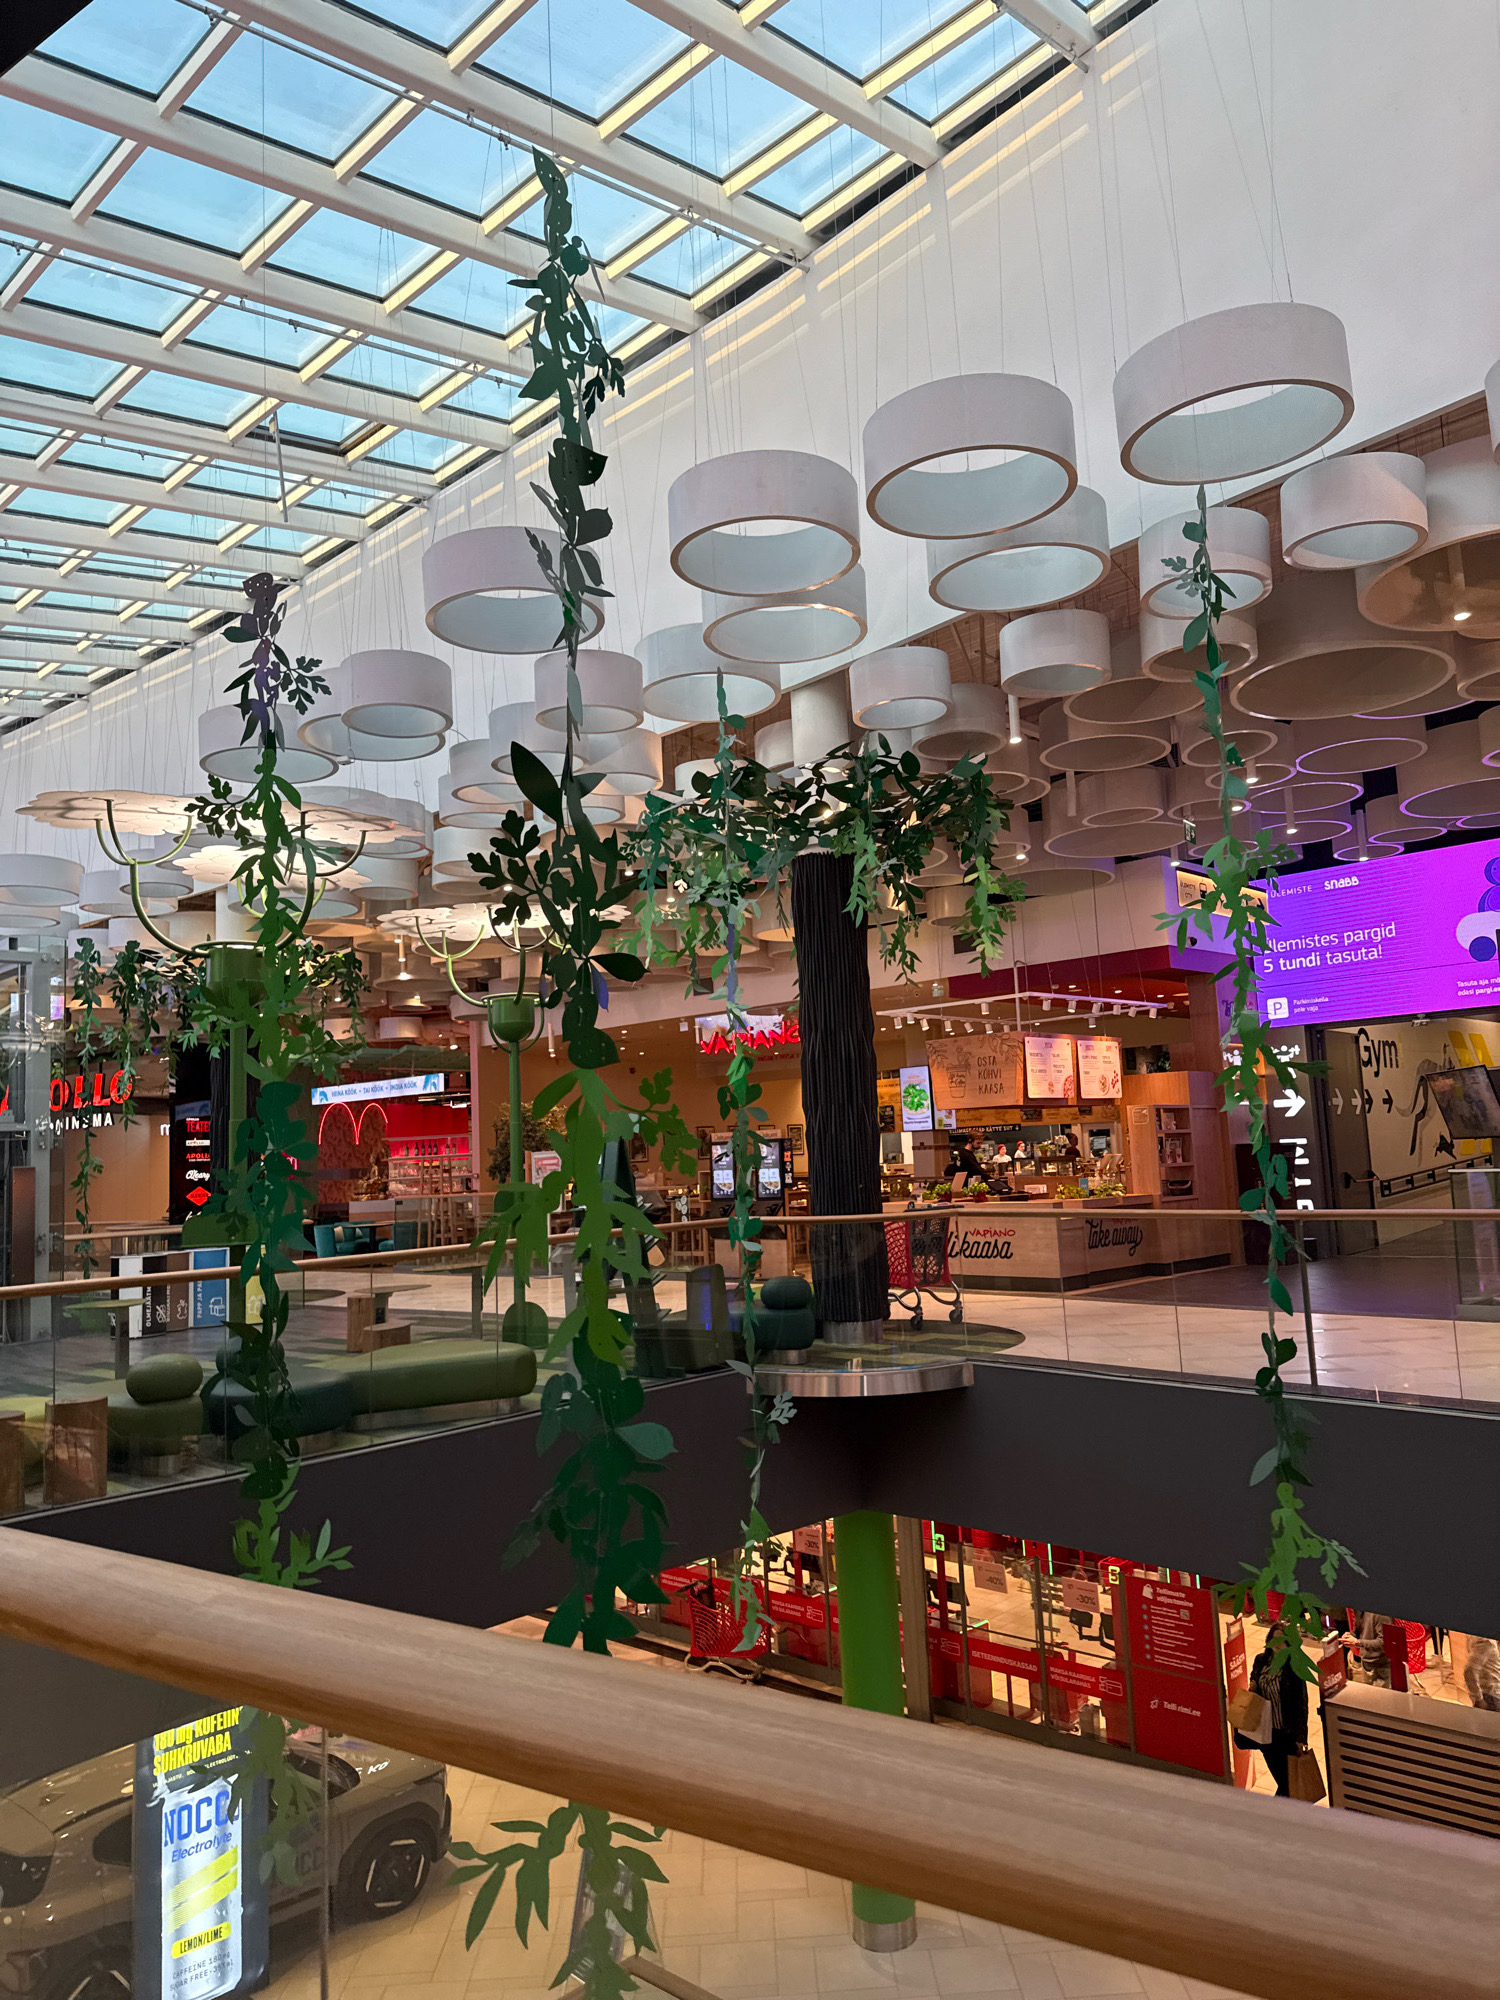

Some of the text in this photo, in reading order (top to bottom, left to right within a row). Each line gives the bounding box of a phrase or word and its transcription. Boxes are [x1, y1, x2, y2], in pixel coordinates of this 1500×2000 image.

[1343, 921, 1396, 944] pargid
[1263, 944, 1383, 973] 5 tundi tasuta!
[1457, 979, 1477, 987] Tasuta
[1479, 978, 1489, 986] aja
[1457, 988, 1474, 996] edasi
[977, 1055, 997, 1067] OSTA
[978, 1068, 1002, 1080] KOHVI
[979, 1083, 1004, 1095] KAASA
[186, 1121, 210, 1133] TEATE
[194, 1705, 243, 1738] KOFEIIN
[153, 1731, 232, 1777] SUHKRUVABA
[172, 1832, 232, 1863] Electrolyte
[180, 1926, 223, 1954] LEMON/LIME
